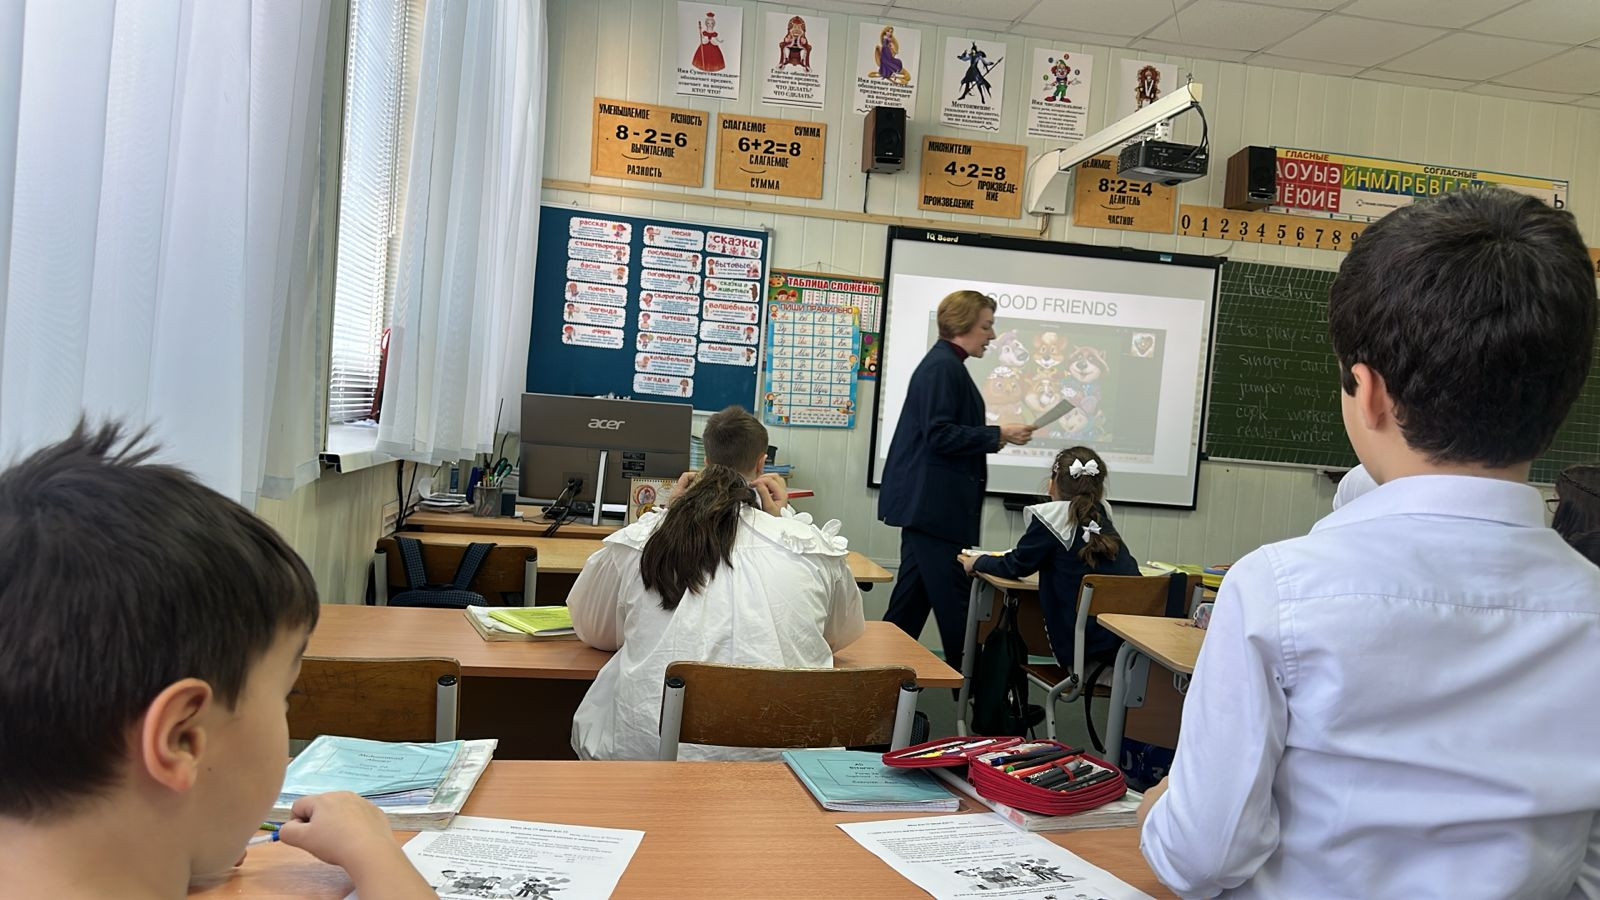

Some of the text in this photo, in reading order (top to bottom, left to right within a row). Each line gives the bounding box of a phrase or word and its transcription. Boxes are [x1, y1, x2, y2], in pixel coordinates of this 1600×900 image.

[599, 103, 703, 127] УМЕНЬШАЕМОЕ РАЗНОСТЬ
[722, 119, 821, 138] СЛАГАЕМОЕ СУММА
[631, 142, 676, 159] ВЫЧИТАЕМОЕ
[928, 141, 972, 156] МНОЖИТЕЛИ
[749, 154, 790, 169] СЛАГАЕМОЕ
[1285, 150, 1478, 180] ГЛАСНЫЕ СОГЛАСНЫЕ
[626, 164, 663, 178] РАЗНОСТЬ
[750, 177, 781, 190] СУММА
[923, 195, 974, 210] ПРОИЗВЕДЕНИЕ
[985, 191, 999, 202] НИЕ
[1108, 193, 1141, 206] ДЕЛИТЕЛЬ
[579, 219, 608, 228] рассказ
[1107, 215, 1134, 226] ЧАСТНОЕ
[1182, 215, 1190, 230] 0
[1202, 217, 1208, 231] 1
[1220, 219, 1229, 232] 2
[1240, 222, 1248, 236] 3
[1256, 224, 1265, 237] 4
[1277, 225, 1286, 238] 5
[1296, 227, 1304, 240] 6
[1316, 230, 1324, 242] 7
[1332, 230, 1341, 244] 8
[713, 235, 757, 249] сказки
[926, 232, 959, 243] IQ Board
[715, 260, 751, 269] бытовые
[647, 271, 681, 280] поговорка
[787, 276, 880, 294] ТАБЛИЦА СЛОЖЕНИЯ
[708, 302, 754, 312] волшебные
[781, 303, 853, 315] ПИШИ ПРАВИЛЬНО
[1042, 297, 1118, 317] FRIENDS
[1238, 318, 1258, 336] to
[1266, 326, 1297, 352] play
[1239, 353, 1329, 379] singer and
[1239, 373, 1286, 408] jumper
[1294, 382, 1321, 399] and
[588, 418, 625, 430] acer
[1291, 424, 1334, 442] writer
